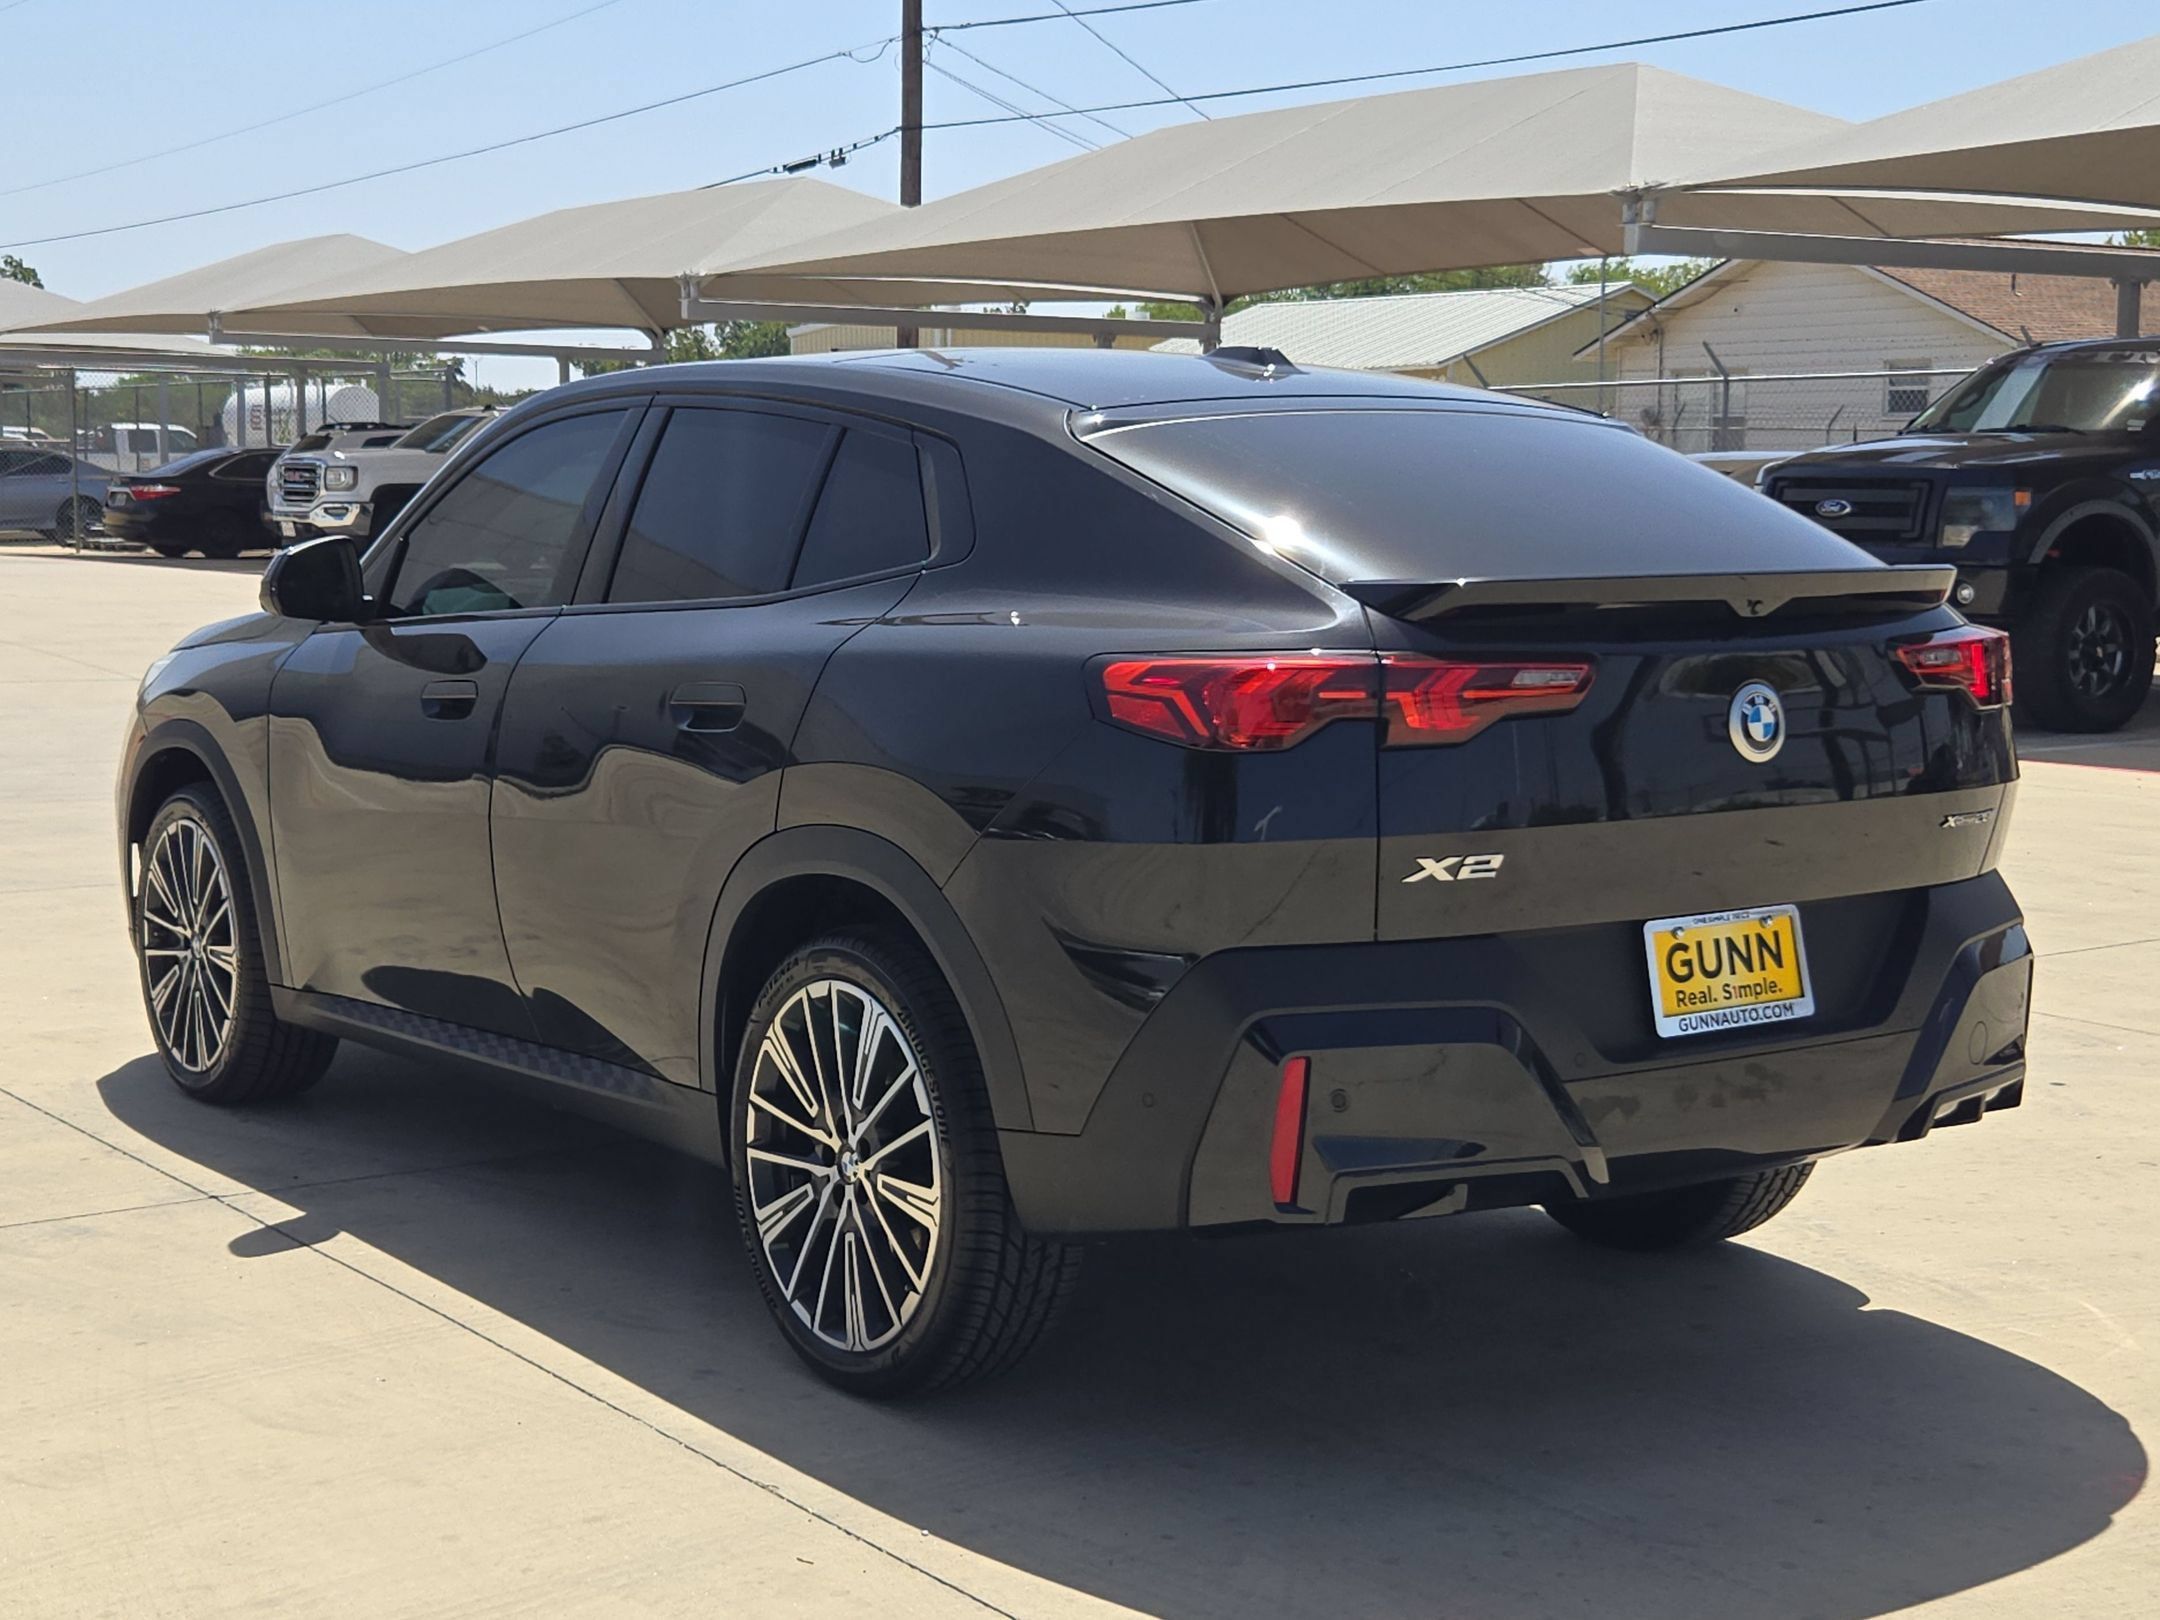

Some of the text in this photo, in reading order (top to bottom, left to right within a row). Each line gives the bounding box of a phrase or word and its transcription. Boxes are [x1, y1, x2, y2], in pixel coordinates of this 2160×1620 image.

[1742, 694, 1777, 715] BMW
[1401, 854, 1504, 883] X2
[1666, 930, 1784, 983] GUNN
[1676, 985, 1718, 1008] Real.
[1678, 1003, 1795, 1033] GUNNAUTO.COM
